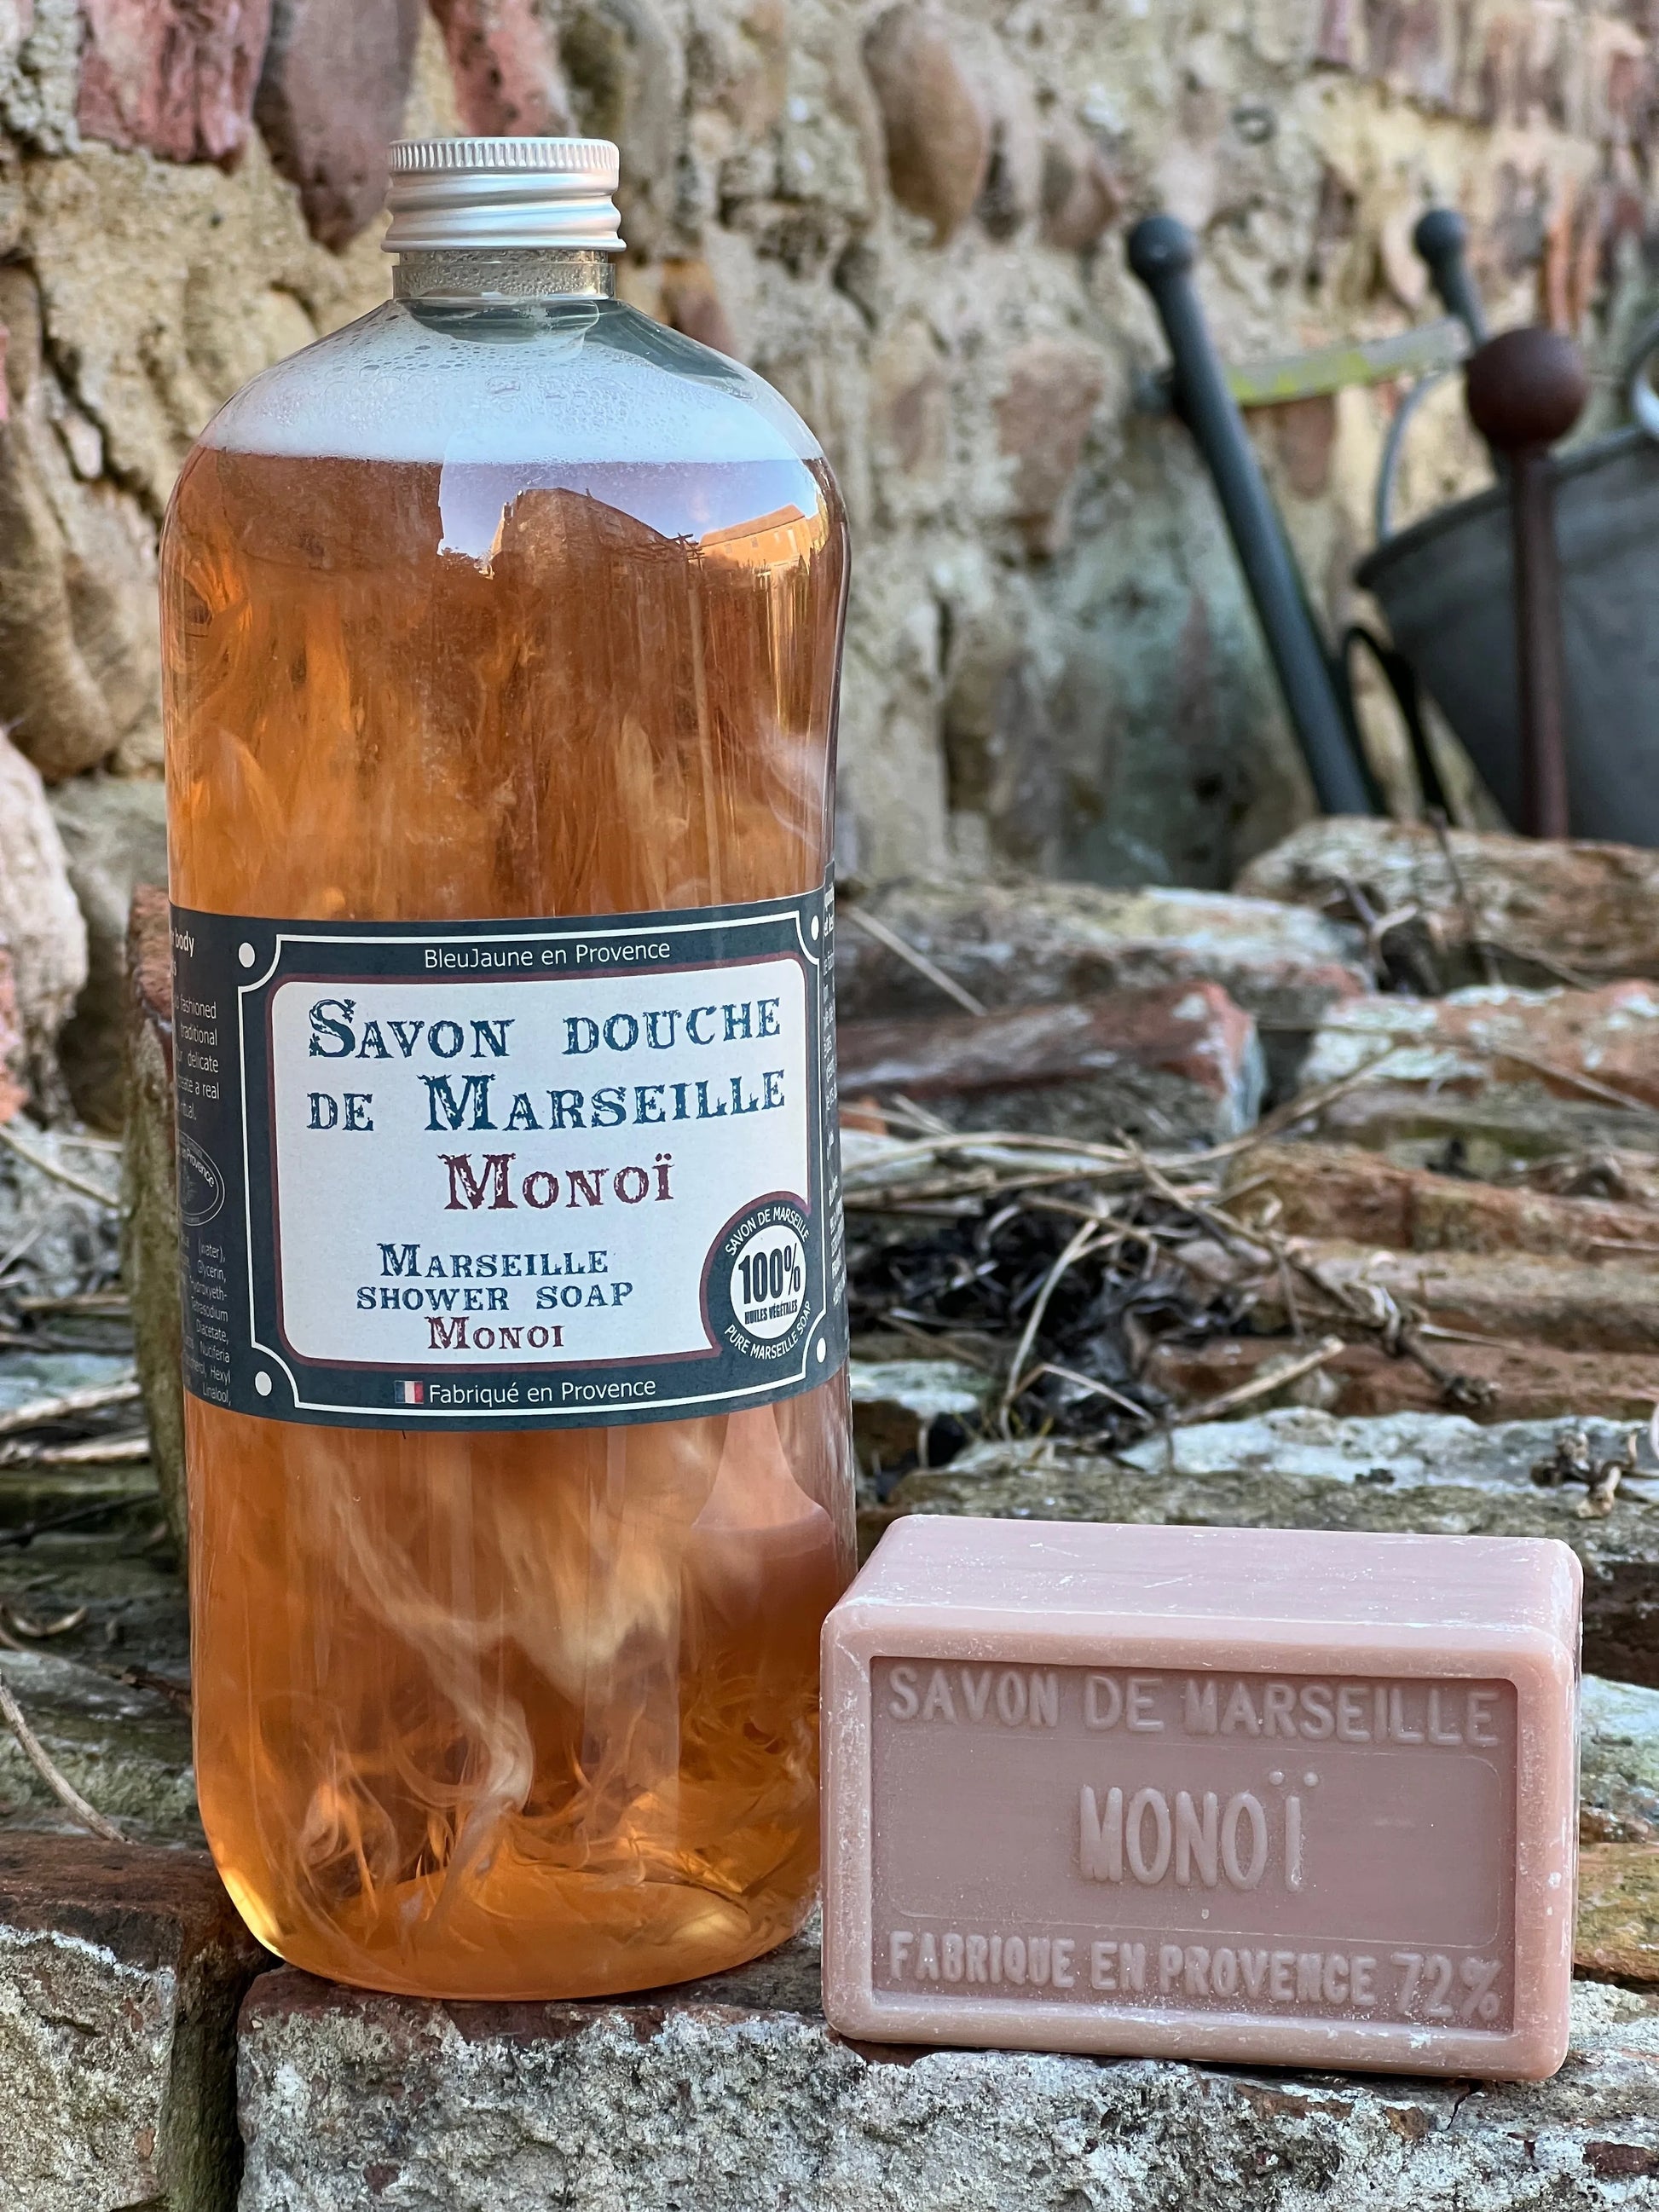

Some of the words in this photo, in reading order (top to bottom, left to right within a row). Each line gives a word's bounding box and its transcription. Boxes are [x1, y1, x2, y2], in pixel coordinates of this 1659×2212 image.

[175, 927, 194, 957] body
[425, 948, 534, 968] BleuJaune
[541, 949, 567, 965] en
[575, 941, 671, 963] Provence
[180, 993, 217, 1019] fashioned
[180, 1022, 218, 1046] traditional
[562, 998, 779, 1054] DOUCHE
[188, 1049, 220, 1073] delicate
[195, 1081, 200, 1096] a
[203, 1082, 220, 1100] real
[307, 1093, 373, 1131] DE
[725, 1216, 757, 1256] SAVON
[757, 1209, 771, 1226] DE
[773, 1206, 810, 1242] MARSEILLE
[738, 1242, 801, 1304] 100%
[357, 1287, 509, 1311] SHOWER
[536, 1282, 633, 1309] SOAP
[744, 1308, 768, 1325] HUILES
[768, 1299, 798, 1320] VÉGÉTALES
[725, 1324, 752, 1354] PURE
[750, 1330, 800, 1360] MARSEILLE
[796, 1300, 812, 1337] SOAP
[210, 1365, 231, 1386] Hexyl
[430, 1382, 519, 1407] Fabriqué
[527, 1386, 553, 1403] en
[562, 1379, 656, 1401] Provence
[888, 1666, 1061, 1729] SAVON
[1084, 1673, 1166, 1734] DE
[1184, 1679, 1503, 1748] MARSEILLE
[1078, 1770, 1319, 1893] MONOÏ
[888, 1929, 1078, 1990] FABRIQUE
[1090, 1940, 1147, 1992] EN
[1160, 1943, 1378, 2007] PROVENCE
[1390, 1950, 1504, 2022] 72%
